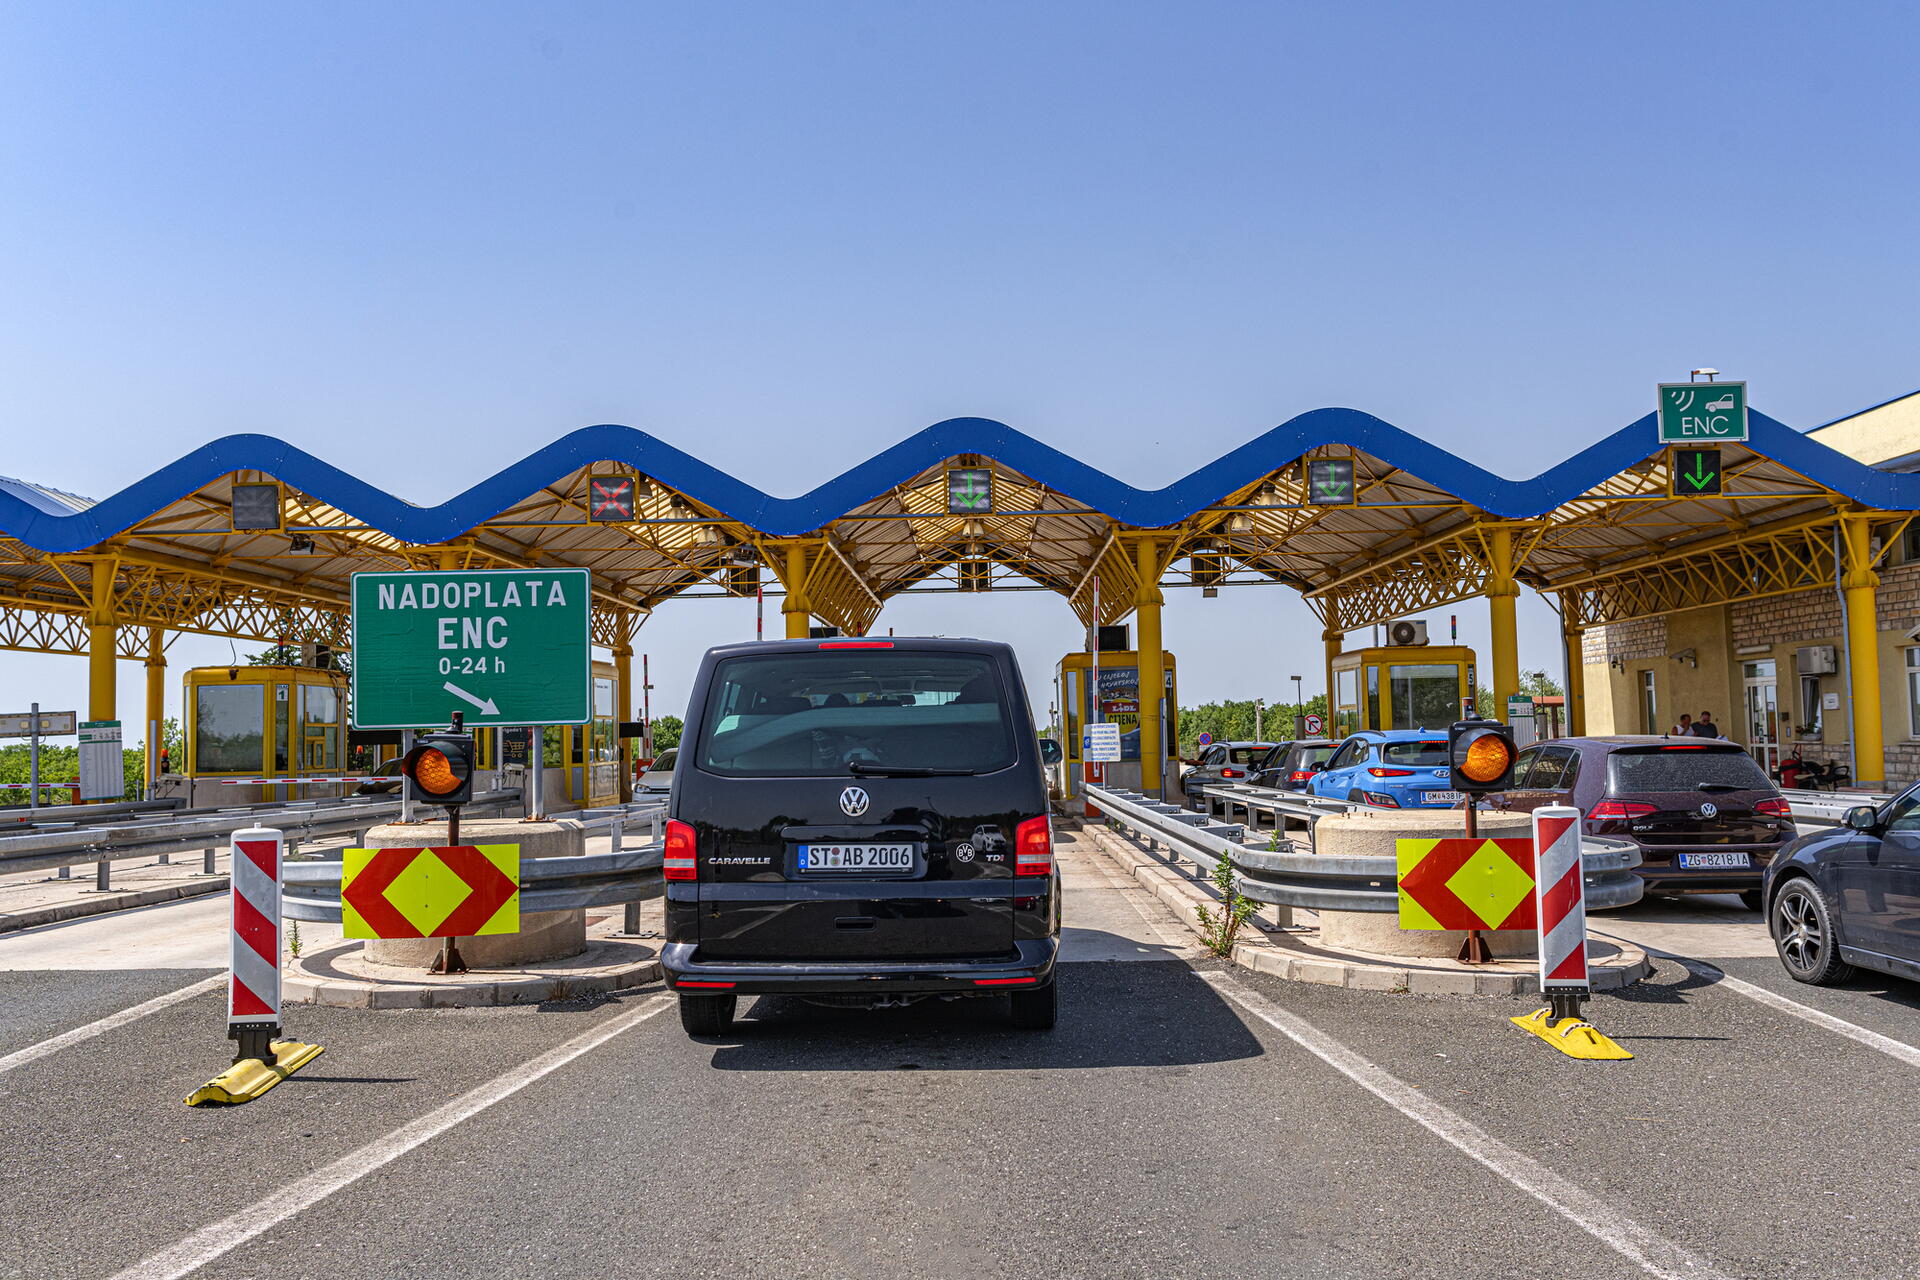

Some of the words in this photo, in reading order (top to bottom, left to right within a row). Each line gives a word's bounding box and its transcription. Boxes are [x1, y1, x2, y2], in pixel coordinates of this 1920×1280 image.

[1682, 416, 1729, 435] ENC
[378, 580, 567, 610] NADOPLATA
[438, 616, 508, 650] ENC
[439, 657, 487, 675] 0-24
[494, 656, 505, 674] h
[1166, 677, 1171, 686] 4
[1469, 673, 1474, 683] 5
[279, 690, 284, 699] 1
[1108, 714, 1137, 725] CIJENA
[809, 847, 831, 866] ST
[842, 847, 864, 866] AB
[868, 847, 910, 866] 2006
[958, 845, 973, 857] BVB
[708, 857, 771, 865] CARAVELLE
[1688, 854, 1701, 866] ZG
